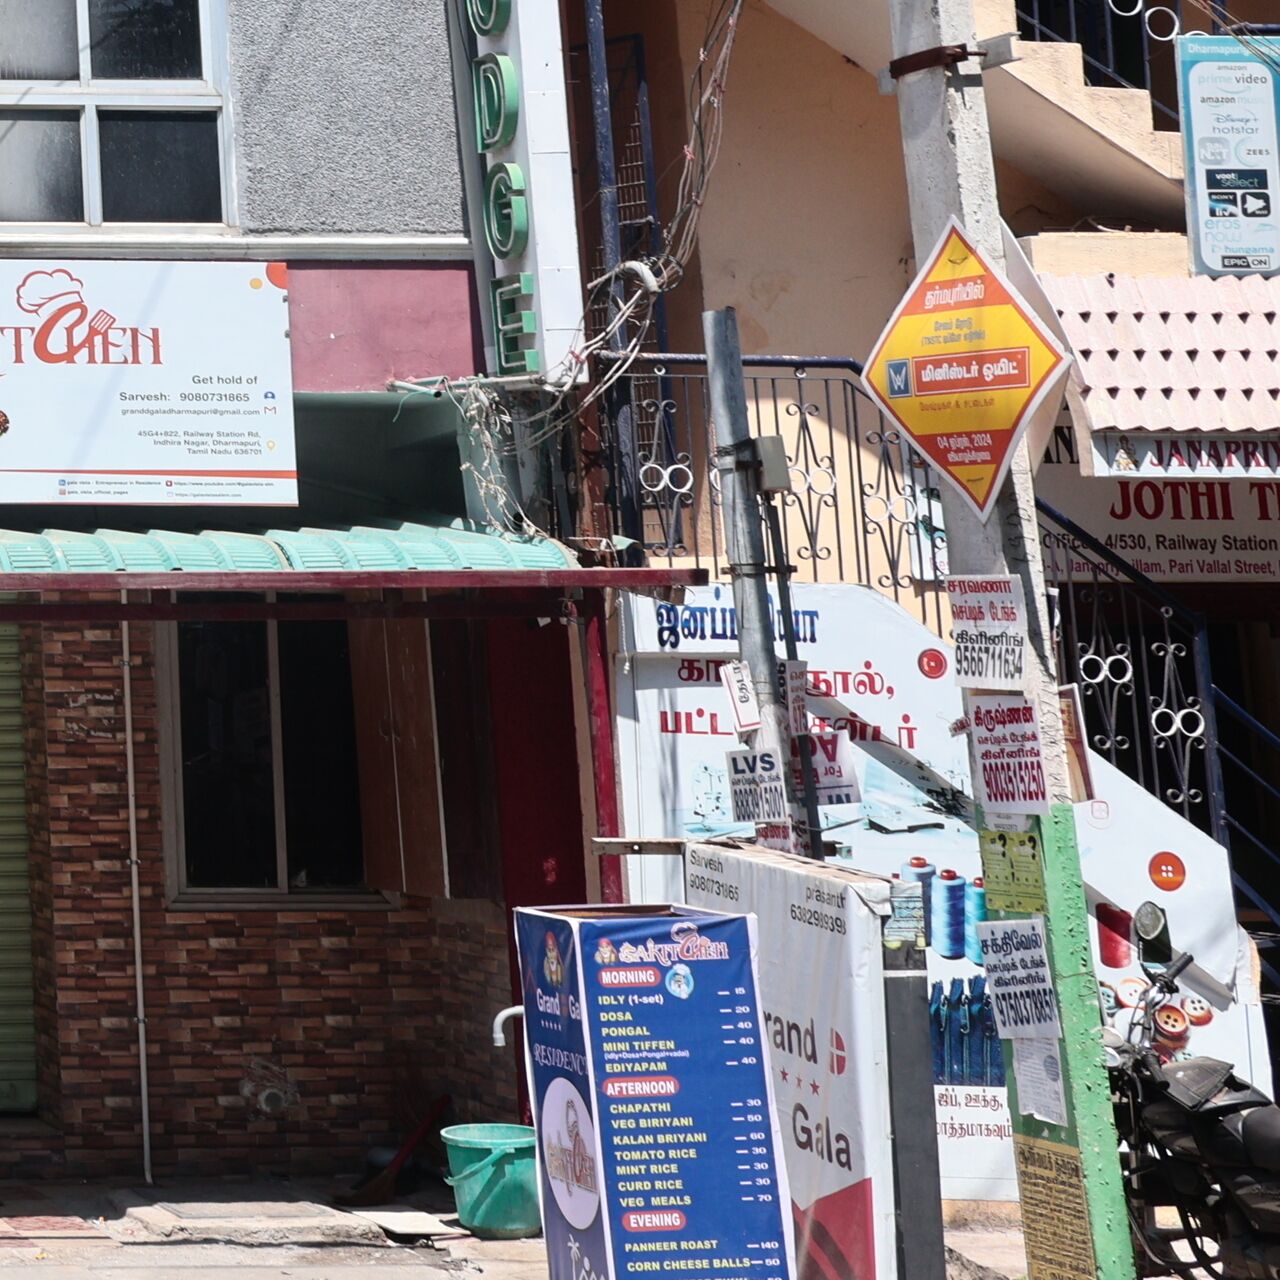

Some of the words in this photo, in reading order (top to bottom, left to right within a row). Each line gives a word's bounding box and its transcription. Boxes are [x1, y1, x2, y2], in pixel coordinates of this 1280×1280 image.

[1234, 73, 1268, 84] video
[1200, 96, 1236, 104] amazon
[192, 375, 213, 385] Get
[217, 375, 243, 385] hold
[246, 375, 258, 385] of
[119, 391, 171, 402] Sarvesh:
[179, 393, 250, 402] 9080731865
[1109, 481, 1235, 521] JOTHI
[1104, 534, 1151, 552] 4/530,
[1156, 535, 1217, 553] Railway
[1222, 535, 1278, 551] Station
[1169, 561, 1193, 574] Pari
[1196, 559, 1231, 574] Vallal
[1234, 560, 1276, 577] Street,
[731, 753, 776, 775] LVS
[690, 850, 724, 874] Sarvesh
[601, 970, 656, 985] MORNING
[598, 995, 625, 1005] IDLY
[599, 1011, 633, 1021] DOSA
[601, 1026, 651, 1037] PONGAL
[763, 1010, 818, 1065] rand
[603, 1042, 630, 1052] MINI
[633, 1040, 675, 1050] TIFFEN
[605, 1062, 668, 1073] EDIYAPAM
[606, 1081, 676, 1096] AFTERNOON
[610, 1102, 671, 1114] CHAPATHI
[746, 1099, 762, 1107] 30
[611, 1119, 637, 1129] VEG
[639, 1117, 694, 1128] BIRIYANI
[613, 1134, 654, 1145] KALAN
[657, 1133, 707, 1144] BRIYANI
[749, 1132, 765, 1140] 60
[792, 1102, 853, 1172] Gala
[615, 1150, 665, 1161] TOMATO
[668, 1149, 697, 1159] RICE
[752, 1147, 767, 1155] 30
[616, 1165, 647, 1175] MINT
[650, 1164, 679, 1174] RICE
[753, 1162, 769, 1170] 30
[618, 1181, 652, 1191] CURD
[655, 1180, 684, 1190] RICE
[755, 1178, 771, 1186] 30
[619, 1197, 645, 1208] VEG
[651, 1195, 692, 1207] MEALS
[629, 1213, 681, 1228] EVENING
[624, 1242, 678, 1253] PANNEER
[680, 1240, 718, 1250] ROAST
[627, 1261, 661, 1272] CORN
[663, 1260, 710, 1270] CHEESE
[712, 1258, 752, 1269] BALLS
